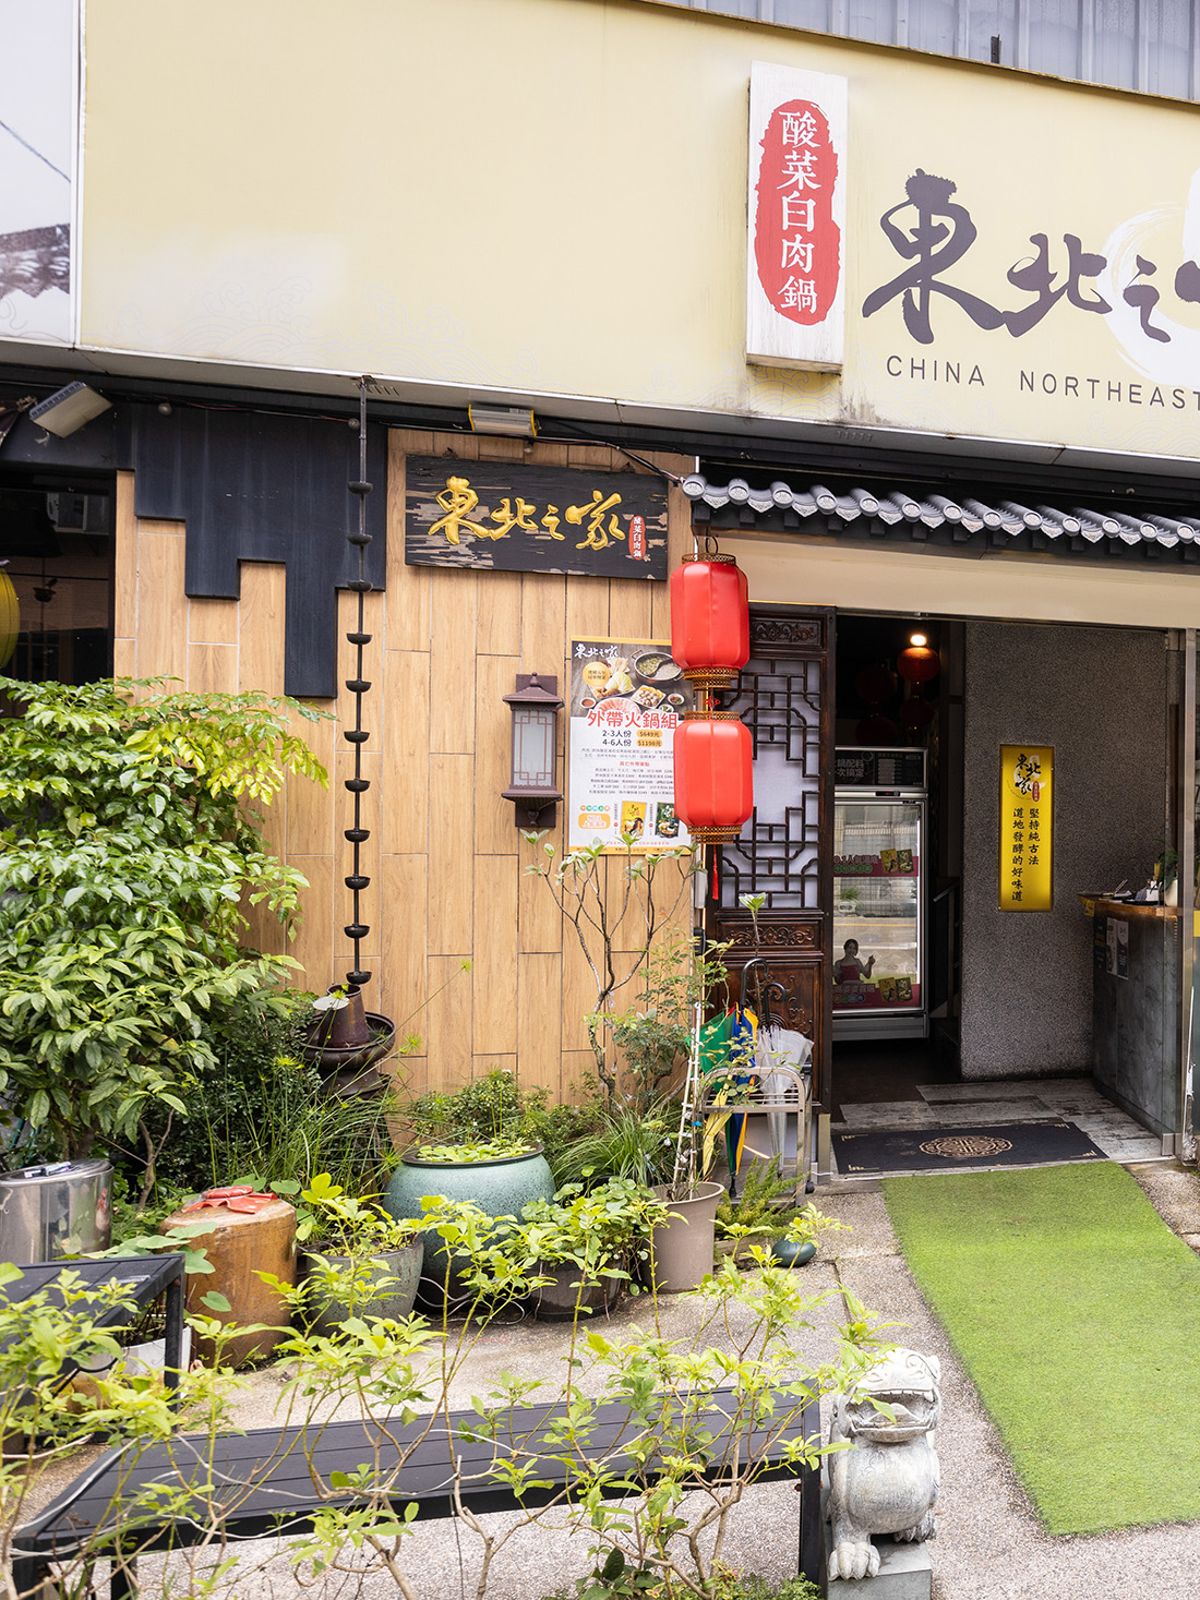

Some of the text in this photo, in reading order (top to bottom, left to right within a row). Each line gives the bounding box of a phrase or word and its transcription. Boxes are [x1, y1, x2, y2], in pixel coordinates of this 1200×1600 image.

[777, 111, 821, 314] 酸菜白肉鍋
[886, 354, 985, 386] CHINA
[428, 476, 626, 551] 東北之家
[587, 710, 678, 729] 外帶火鍋組
[602, 729, 632, 738] 2-3人份
[602, 738, 632, 747] 4-6人份
[1011, 807, 1024, 901] 道地發酵的好味道
[1028, 808, 1040, 865] 堅持純古法
